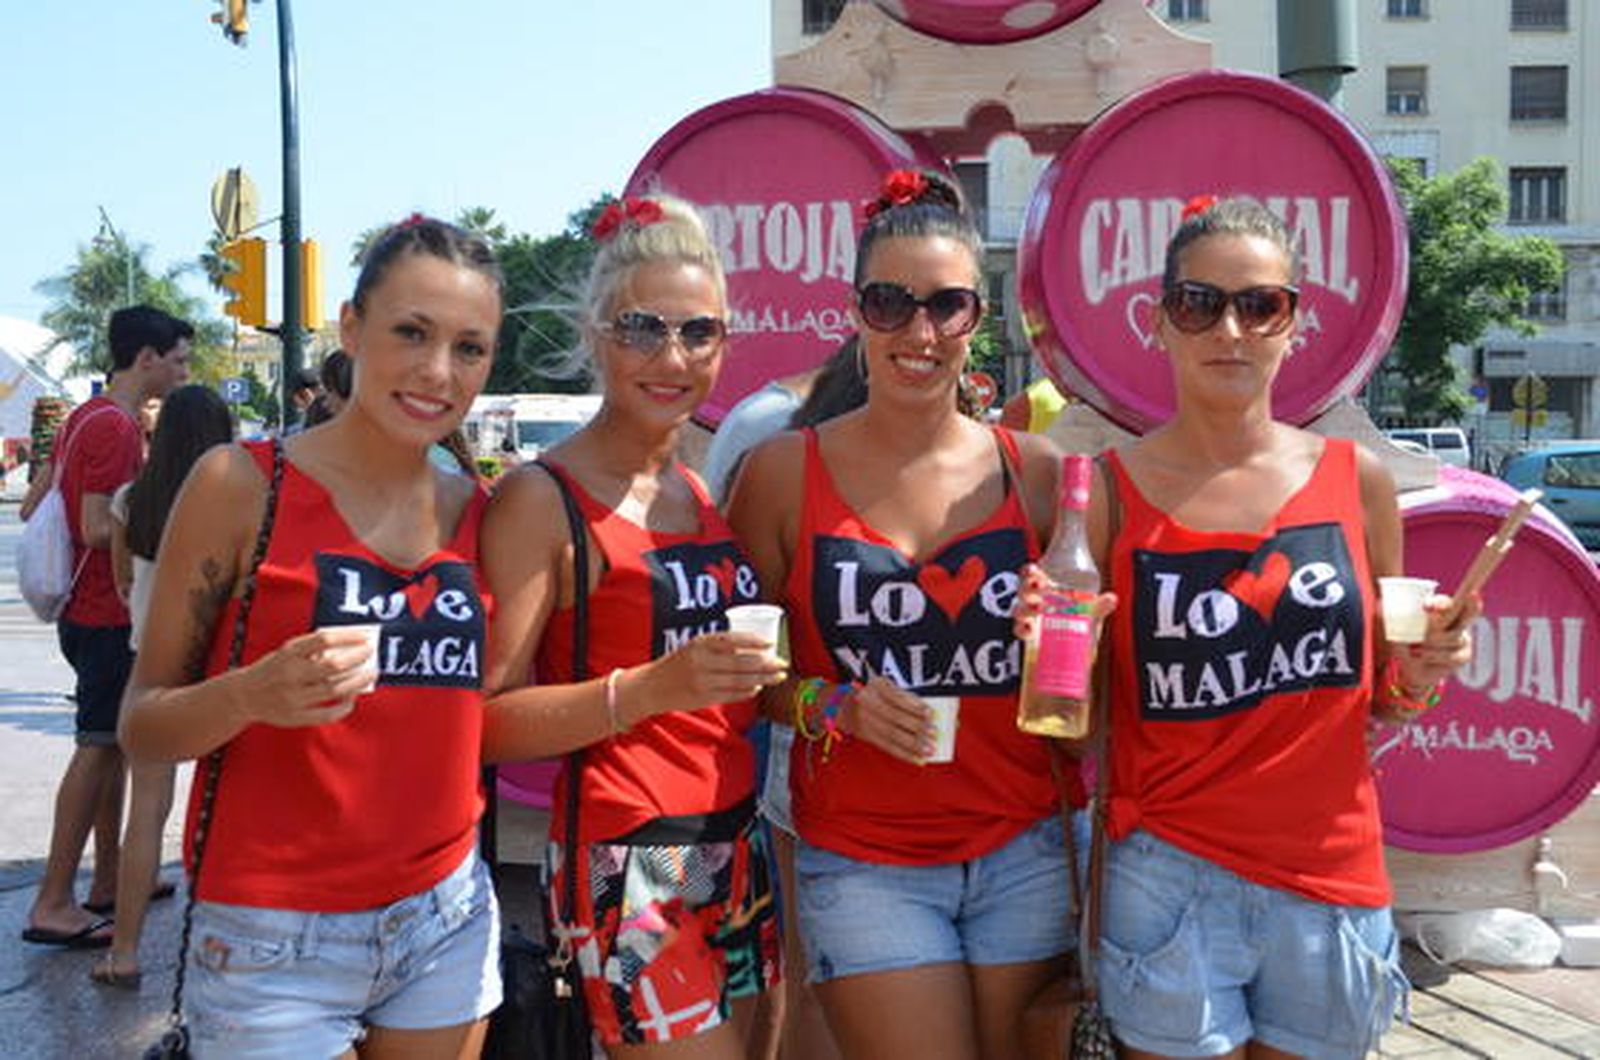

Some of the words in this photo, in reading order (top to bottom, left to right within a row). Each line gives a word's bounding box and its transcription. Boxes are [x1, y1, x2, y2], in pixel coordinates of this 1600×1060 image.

[699, 202, 858, 285] RTOJA
[1080, 196, 1359, 304] CARAL
[227, 381, 241, 399] P
[381, 636, 479, 678] LAGA
[1146, 627, 1354, 709] MALAGA
[1456, 615, 1592, 724] OJAL
